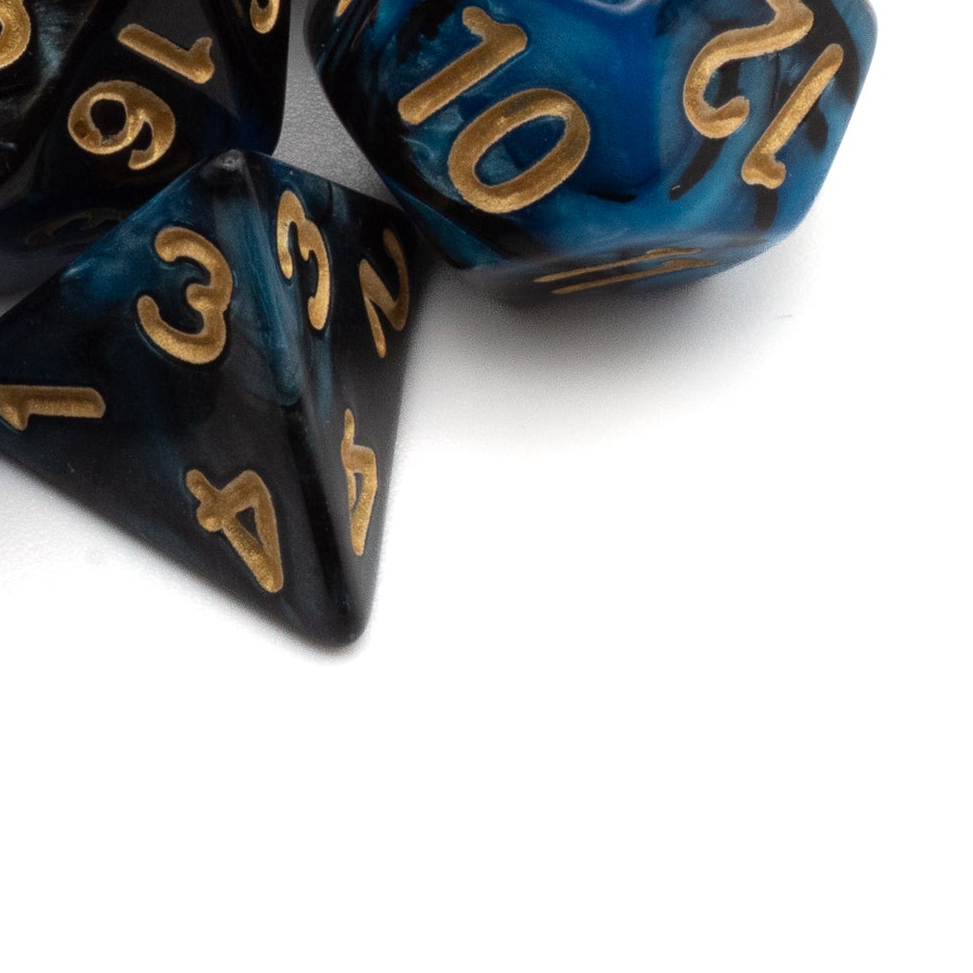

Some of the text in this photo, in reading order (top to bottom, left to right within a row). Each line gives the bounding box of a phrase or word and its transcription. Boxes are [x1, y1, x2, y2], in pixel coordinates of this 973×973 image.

[67, 22, 215, 171] 16
[397, 6, 590, 215] 10
[136, 226, 234, 365] 3
[276, 191, 331, 331] 3
[358, 227, 410, 358] 2
[185, 468, 285, 594] 4
[340, 408, 378, 556] 4
